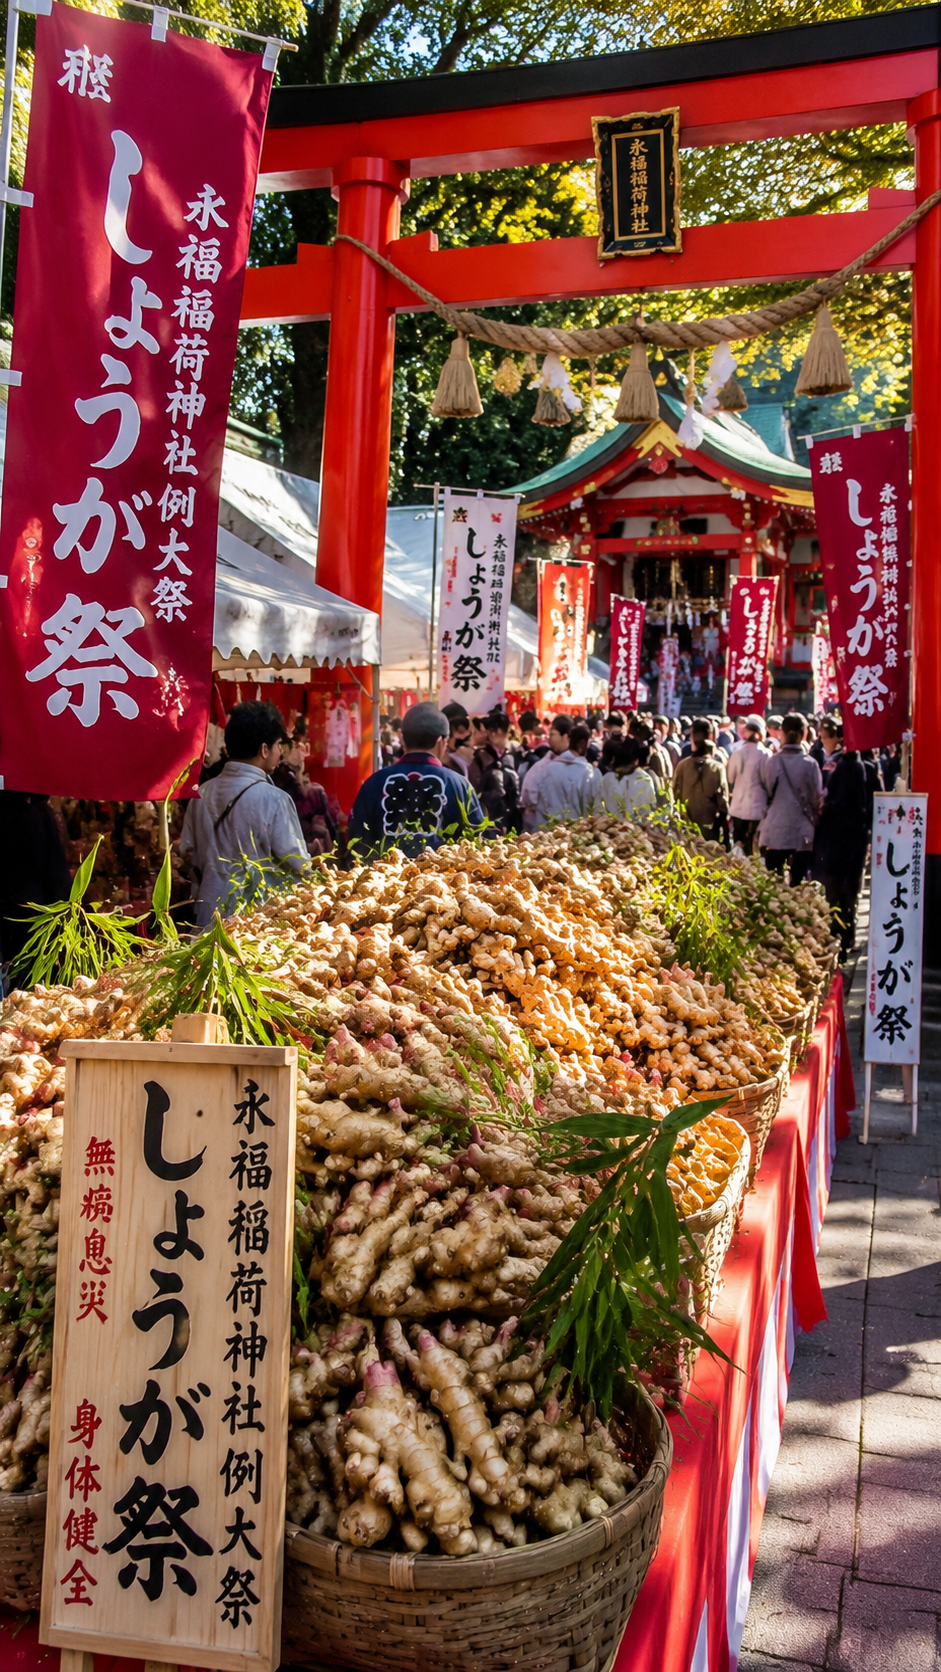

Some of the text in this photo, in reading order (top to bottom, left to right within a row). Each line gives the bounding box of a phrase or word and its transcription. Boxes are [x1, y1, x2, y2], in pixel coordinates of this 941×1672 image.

[25, 129, 163, 728] しょうが祭
[150, 183, 230, 623] 永福福荷神社例大祭
[450, 527, 487, 692] しょうが祭
[846, 479, 889, 717] しょうが祭
[874, 840, 913, 1045] しょうが祭
[60, 1398, 102, 1607] 身体健全
[101, 1080, 214, 1602] しょうが祭
[215, 1078, 276, 1629] 永福稲荷神社例大祭
